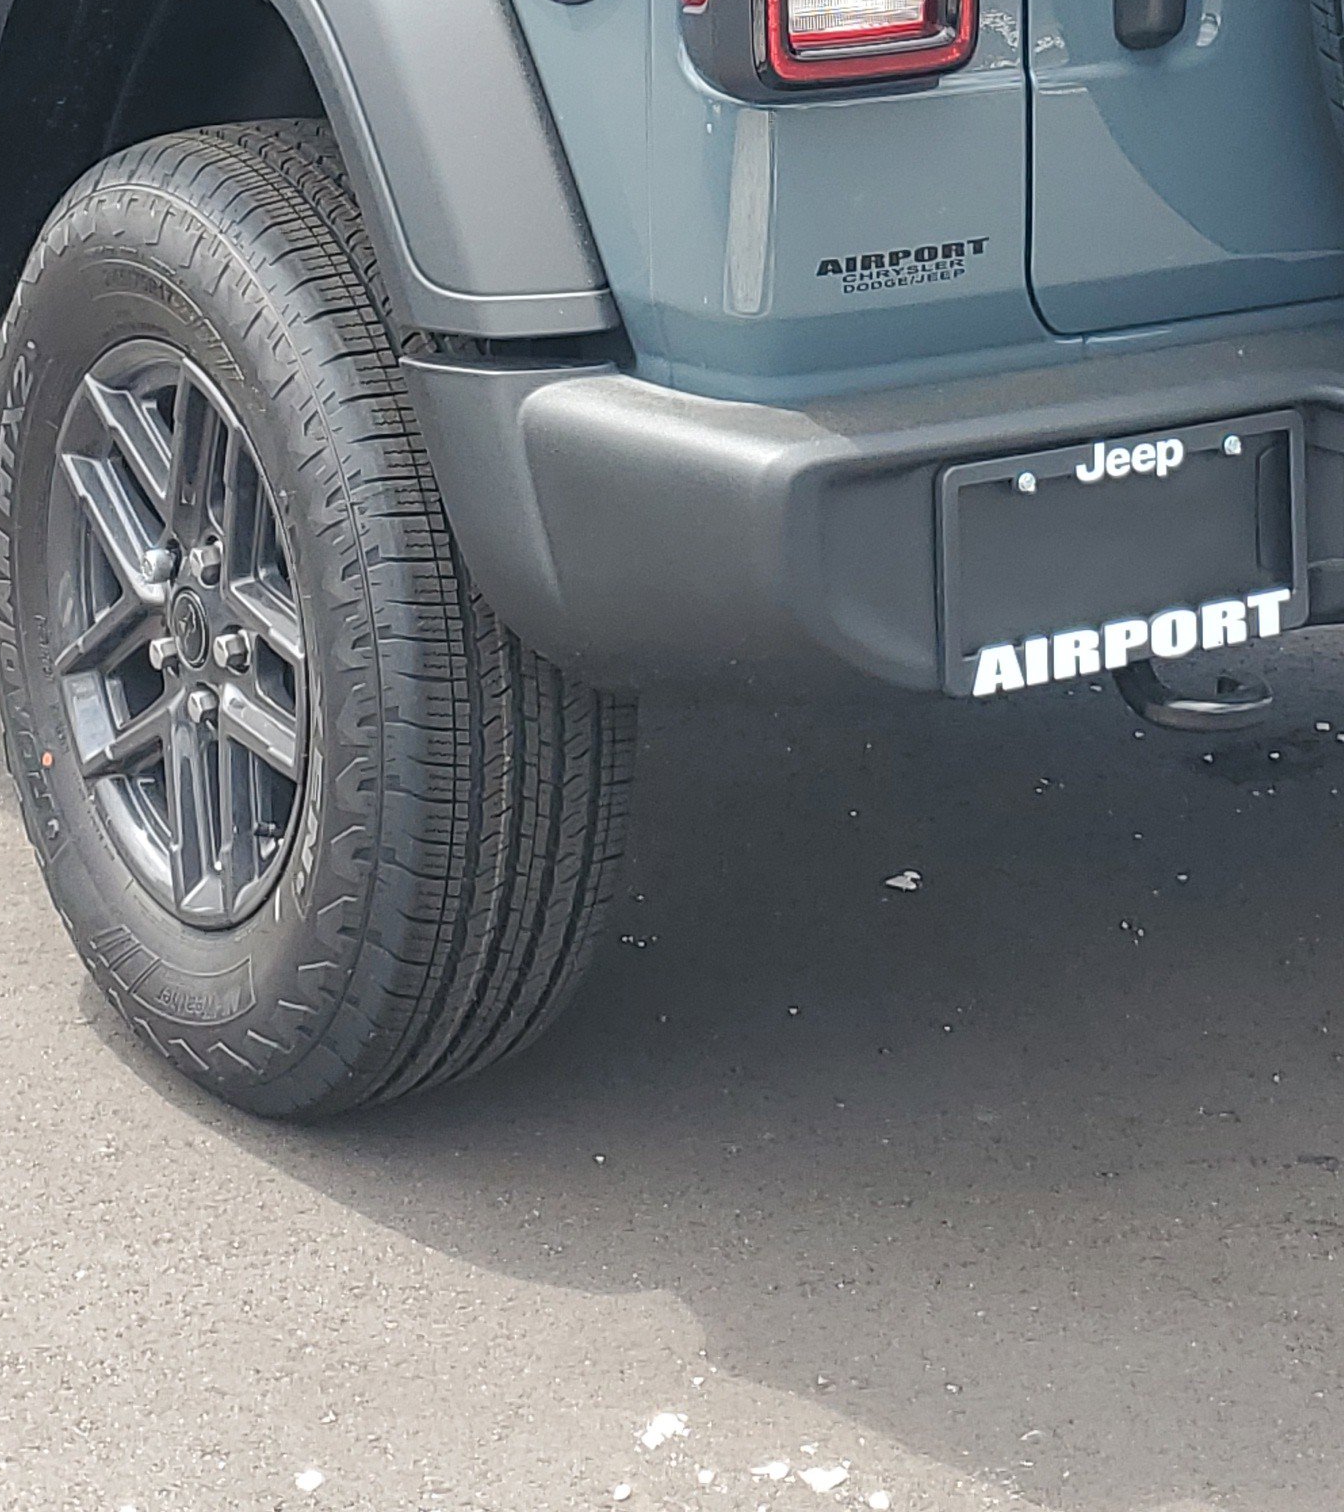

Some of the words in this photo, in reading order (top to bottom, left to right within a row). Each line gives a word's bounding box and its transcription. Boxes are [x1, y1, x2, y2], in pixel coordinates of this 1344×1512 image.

[816, 236, 990, 277] AIRPORT
[842, 258, 965, 283] CHRYSLER
[842, 268, 966, 294] DODGE/JEEP
[1075, 438, 1184, 484] Jeep
[972, 588, 1292, 697] AIRPORT
